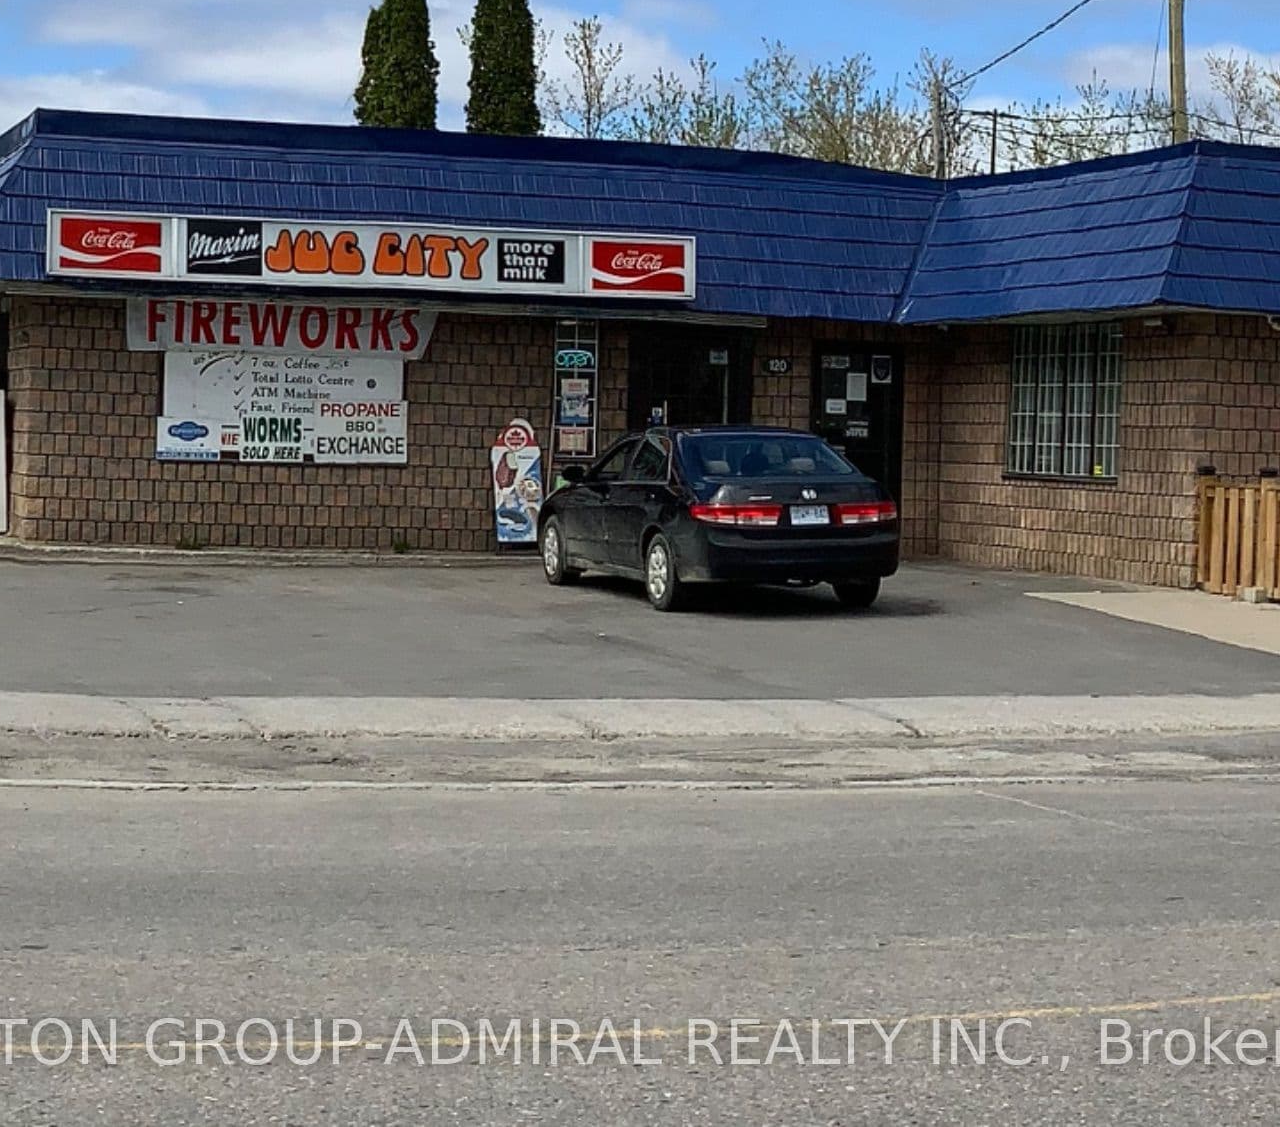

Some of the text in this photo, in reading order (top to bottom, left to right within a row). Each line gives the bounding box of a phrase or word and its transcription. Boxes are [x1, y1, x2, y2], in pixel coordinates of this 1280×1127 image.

[189, 228, 260, 259] Maxim
[503, 242, 556, 255] more
[265, 229, 489, 280] JUG CITY
[503, 254, 548, 268] than
[503, 266, 547, 281] milk
[147, 299, 420, 352] FIREWORKS
[284, 358, 320, 370] Coffee
[769, 359, 787, 372] 120
[251, 371, 355, 386] Total Lotto Centre
[251, 386, 331, 400] ATM Machine
[251, 401, 275, 413] Fast,
[320, 402, 400, 417] PROPANE
[242, 416, 302, 443] WORMS
[345, 421, 375, 433] BBQ
[317, 436, 405, 455] EXCHANGE
[242, 446, 301, 460] SOLD HERE
